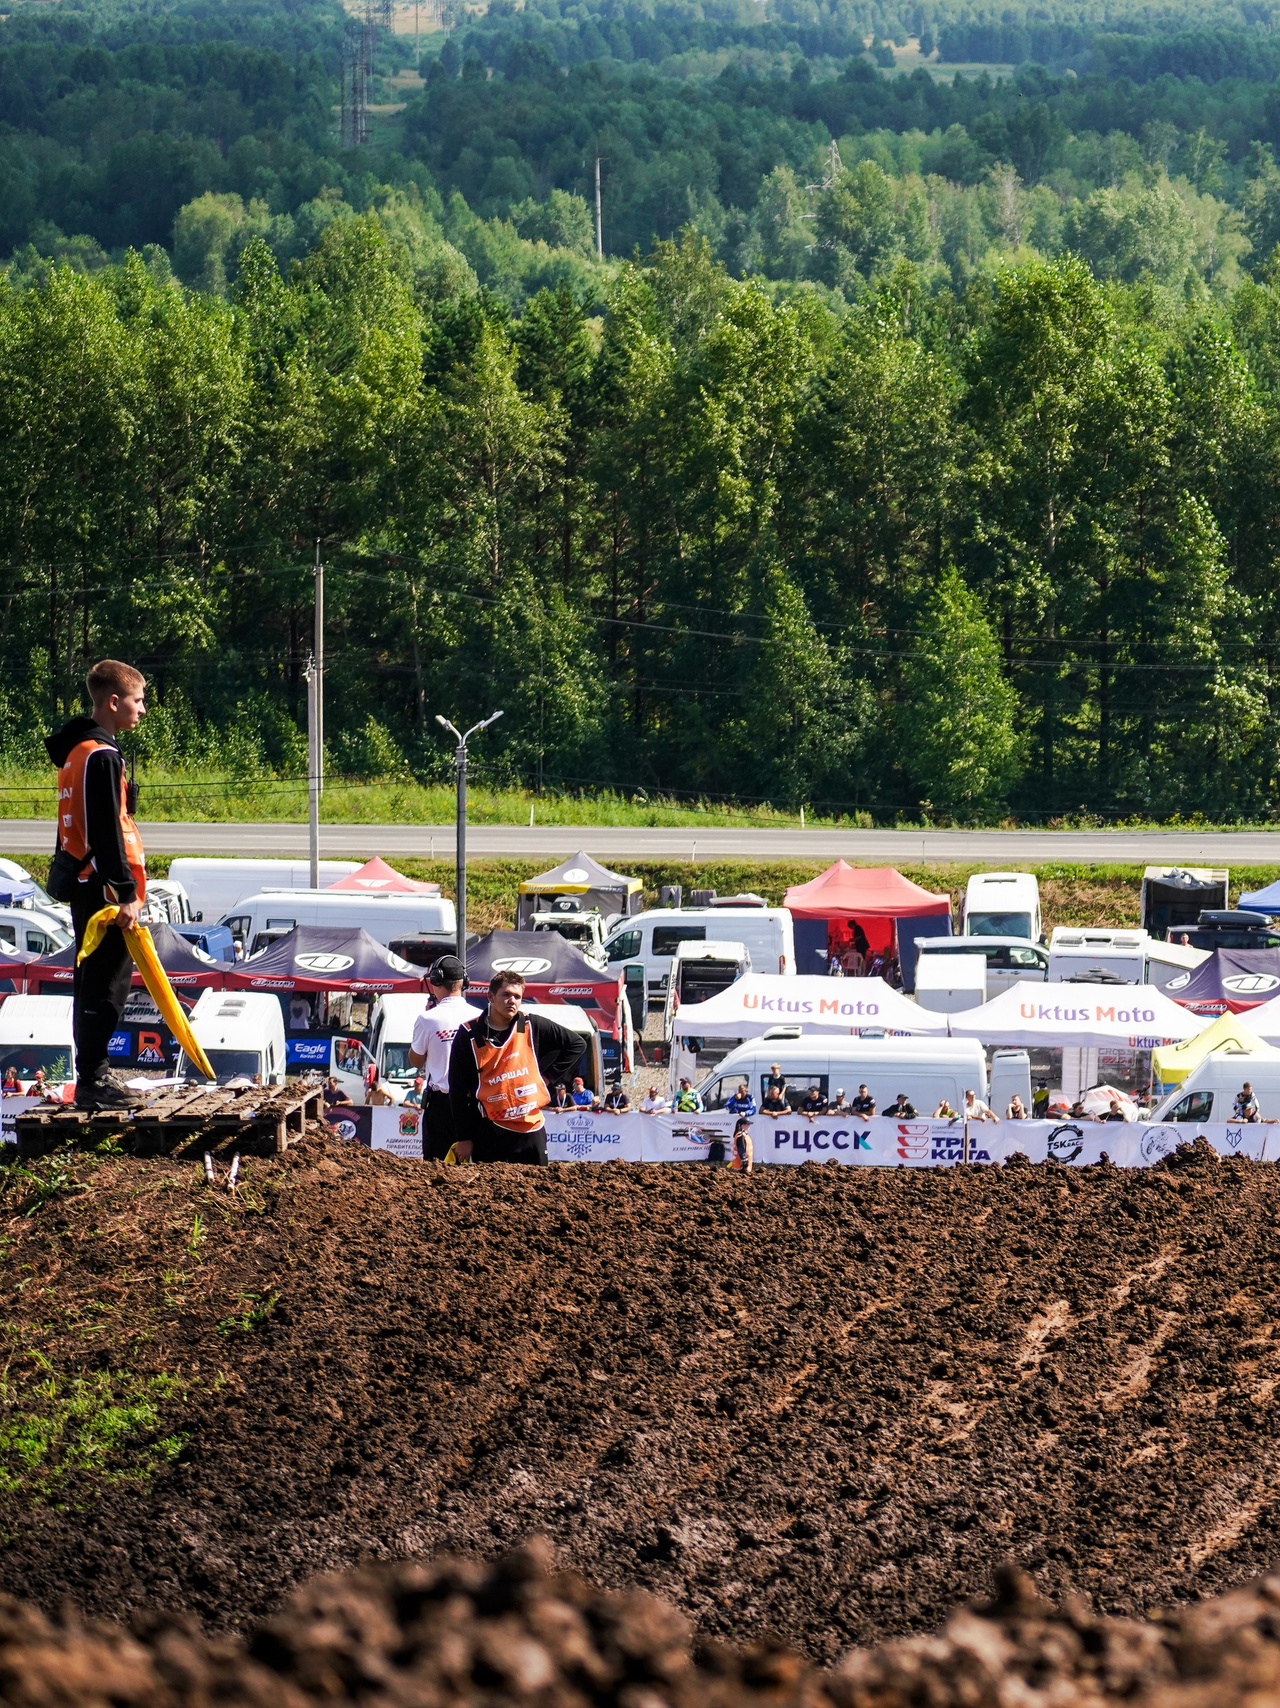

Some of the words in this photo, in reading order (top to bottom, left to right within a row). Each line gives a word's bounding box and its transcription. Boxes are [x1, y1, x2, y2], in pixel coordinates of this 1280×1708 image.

[743, 993, 813, 1013] Uktus
[819, 999, 879, 1016] Moto
[1020, 1003, 1090, 1021] Uktus
[1096, 1006, 1156, 1023] Moto
[108, 1036, 126, 1046] gle
[1128, 1036, 1160, 1048] Uktus
[295, 1043, 327, 1054] Eagle
[488, 1067, 529, 1086] МАРШАЛ
[546, 1133, 621, 1144] CEQUEEN42
[774, 1130, 873, 1153] РЦССК
[931, 1137, 977, 1148] ТРИ
[931, 1149, 991, 1160] КИТА
